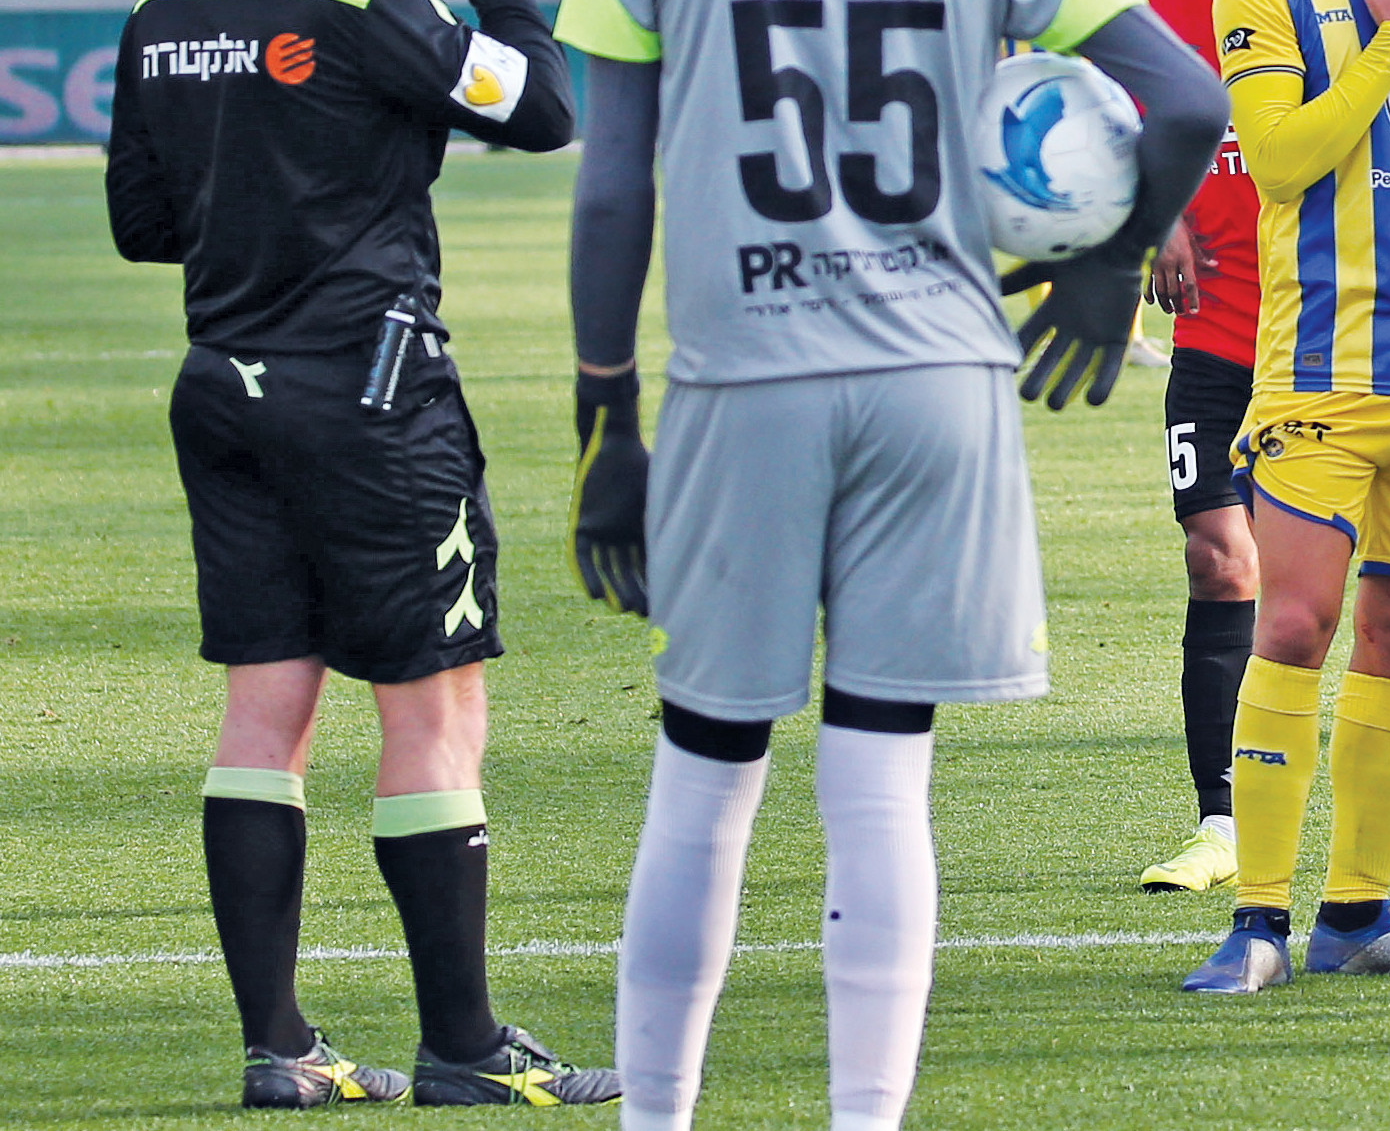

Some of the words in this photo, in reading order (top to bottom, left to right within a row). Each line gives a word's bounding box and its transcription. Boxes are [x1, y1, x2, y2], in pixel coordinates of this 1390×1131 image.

[1316, 8, 1354, 25] MTA
[142, 32, 260, 82] אלקטרה
[738, 242, 808, 294] PR
